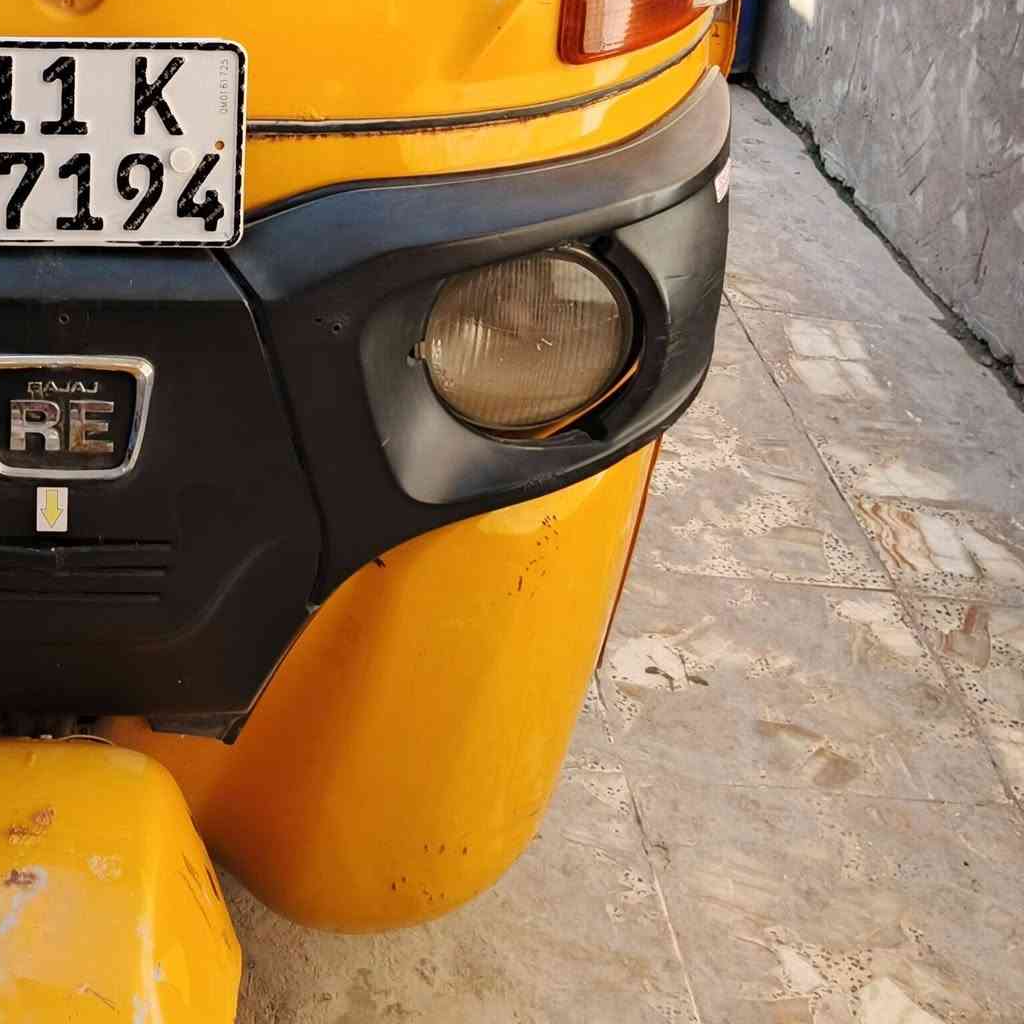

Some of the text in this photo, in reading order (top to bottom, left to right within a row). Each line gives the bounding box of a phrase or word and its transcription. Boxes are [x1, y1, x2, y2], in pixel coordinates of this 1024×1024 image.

[133, 56, 186, 136] K
[27, 381, 98, 394] BAJAJ
[9, 399, 114, 453] RE
